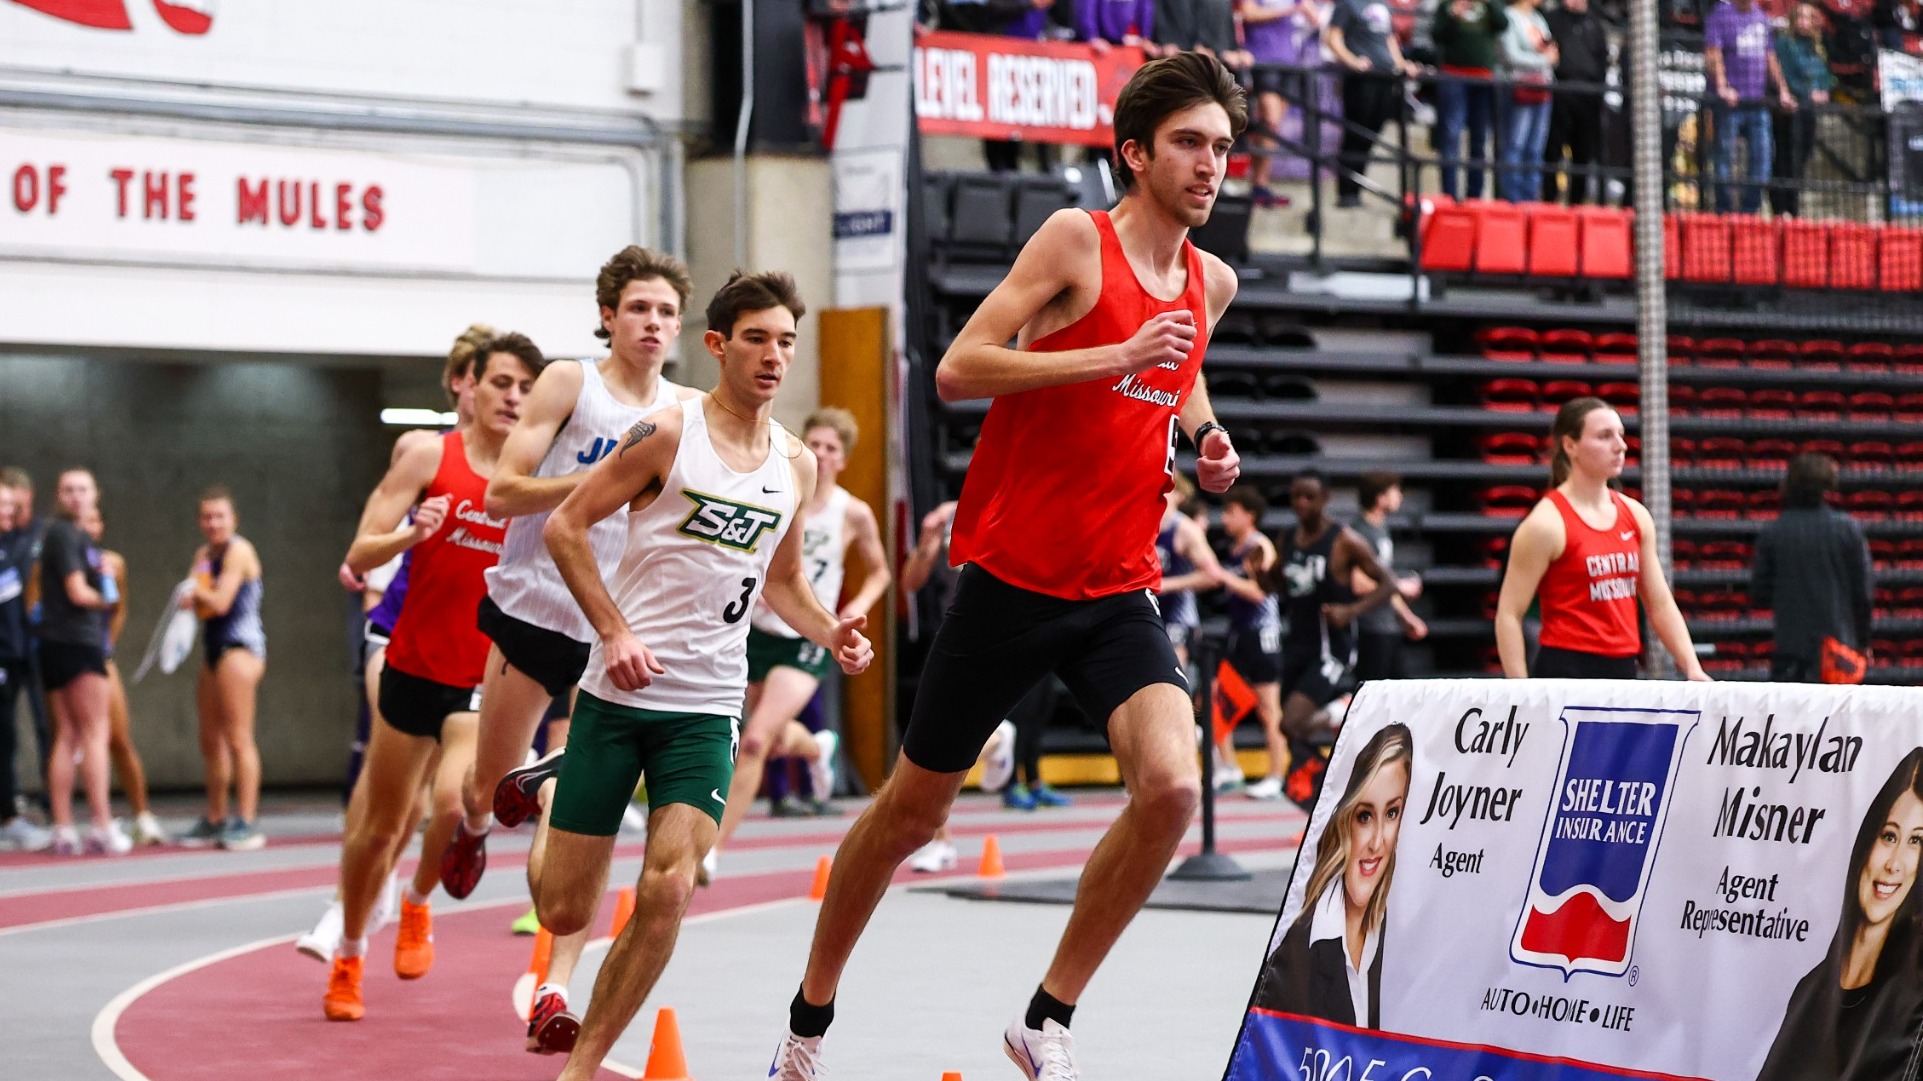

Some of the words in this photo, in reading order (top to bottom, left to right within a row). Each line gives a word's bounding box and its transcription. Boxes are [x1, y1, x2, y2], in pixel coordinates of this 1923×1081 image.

[914, 46, 984, 121] LEVEL
[987, 52, 1098, 130] RESERVED
[13, 164, 67, 214] OF
[111, 168, 196, 221] THE
[236, 176, 386, 232] MULES
[1112, 373, 1181, 407] Missouri
[685, 498, 777, 545] S&T
[722, 577, 757, 624] 3
[1454, 705, 1530, 768] Carly
[1706, 713, 1864, 784] Makaylan
[1419, 771, 1523, 830] Joyner
[1562, 778, 1657, 816] SHELTER
[1712, 785, 1827, 845] Misner
[1555, 816, 1648, 844] INSURANCE
[1429, 842, 1484, 878] Agent
[1715, 865, 1779, 903] Agent
[1680, 900, 1810, 942] Representative
